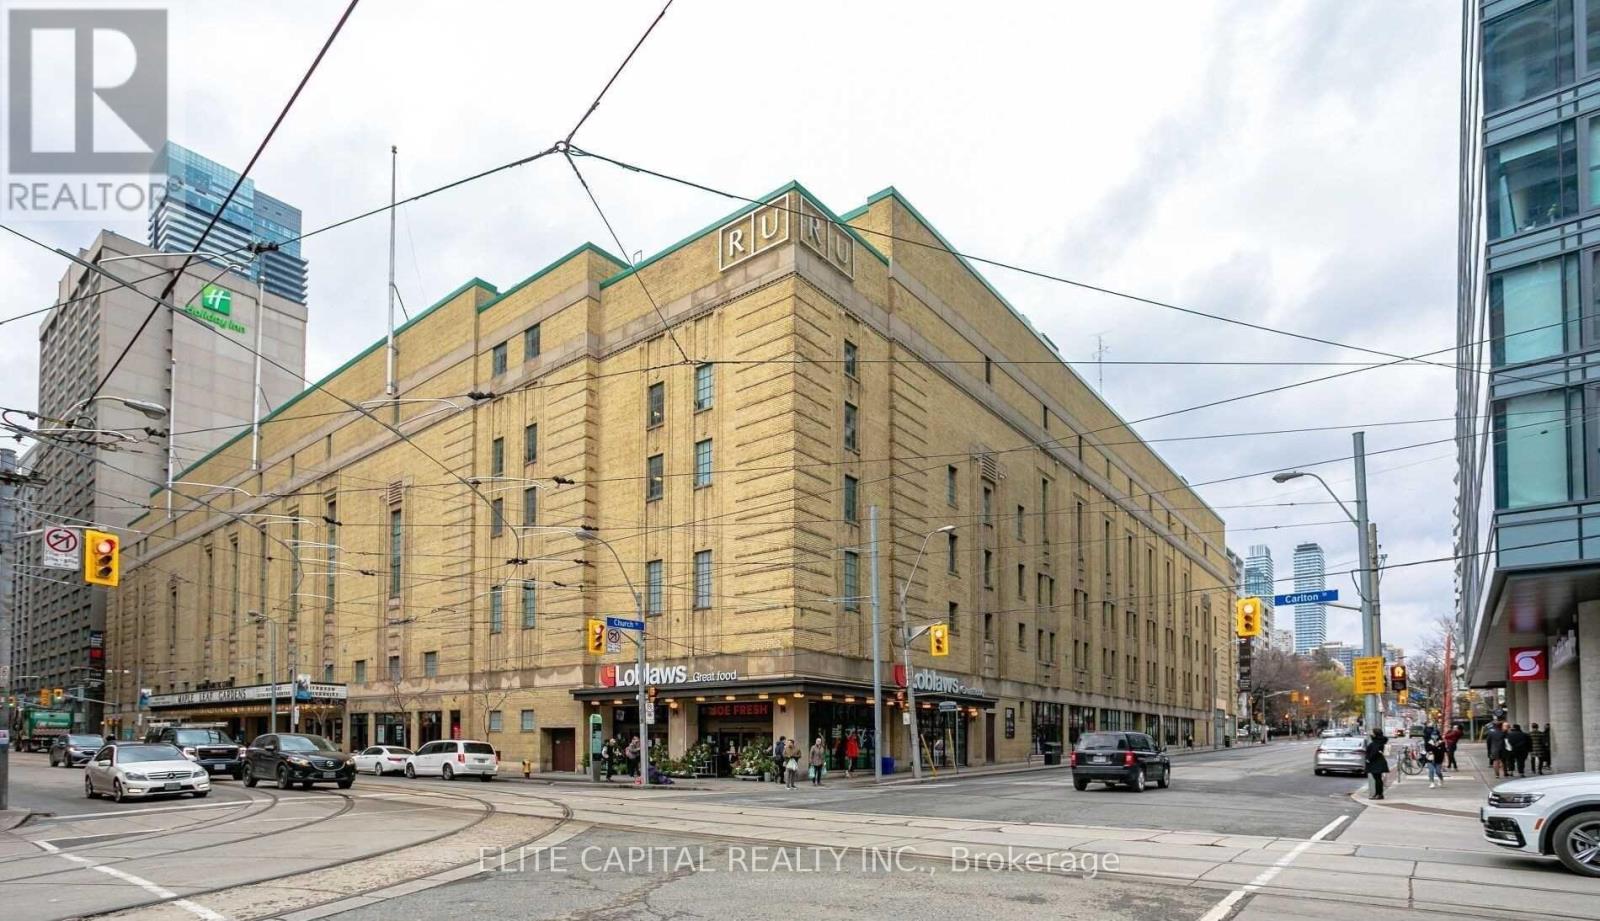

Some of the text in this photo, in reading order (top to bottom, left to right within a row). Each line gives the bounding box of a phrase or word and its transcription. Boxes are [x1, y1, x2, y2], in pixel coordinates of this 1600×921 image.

[1285, 594, 1319, 604] Carlton
[613, 618, 634, 628] Church
[692, 671, 715, 682] Great
[716, 669, 737, 681] food
[913, 668, 960, 694] oblaws
[177, 693, 194, 703] MAPLE
[219, 688, 247, 701] GARDENS
[733, 704, 769, 715] FRESH
